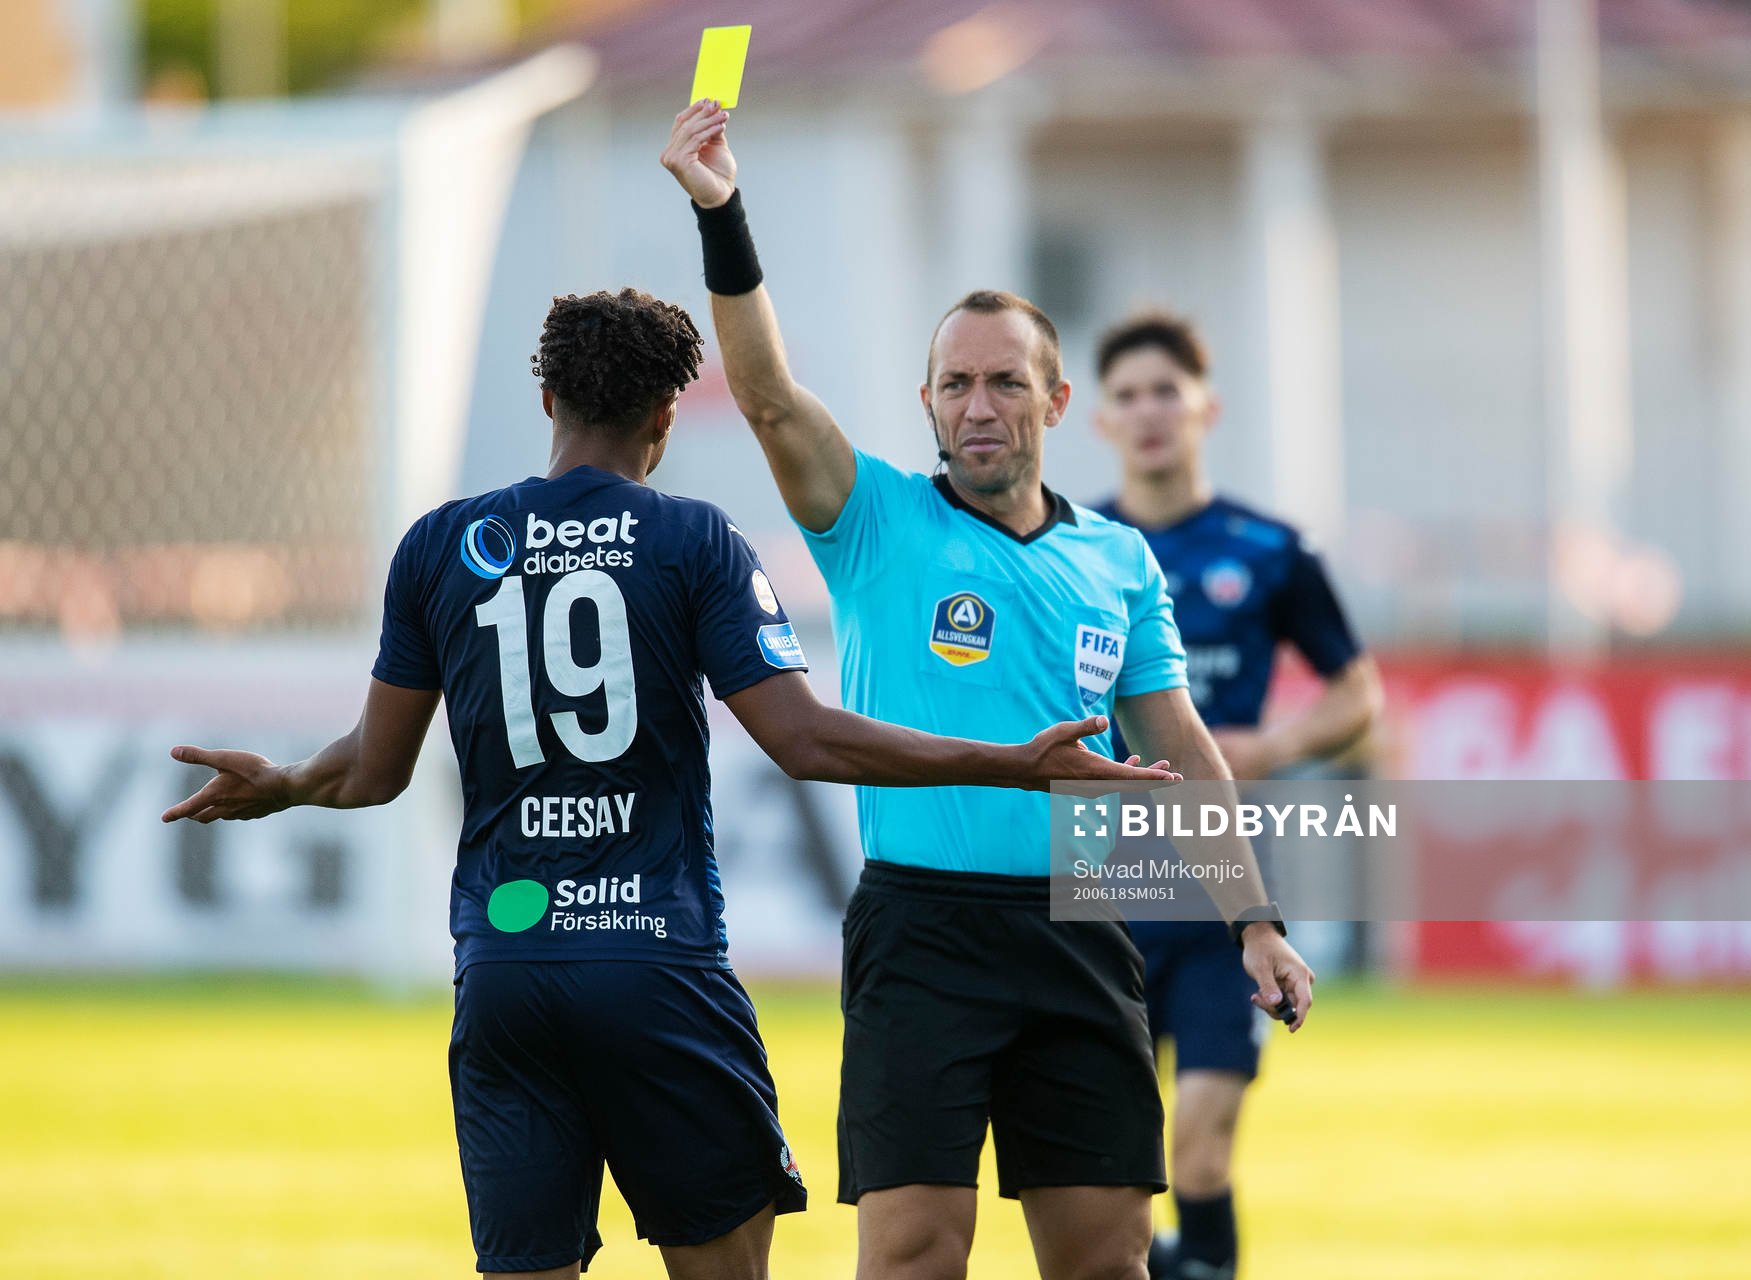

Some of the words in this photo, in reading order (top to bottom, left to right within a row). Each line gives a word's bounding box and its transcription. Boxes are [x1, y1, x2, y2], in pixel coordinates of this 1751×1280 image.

[525, 510, 639, 550] beat
[523, 546, 634, 575] diabetes
[936, 629, 987, 648] ALLSVENSKAN
[1081, 631, 1119, 659] FIFA
[475, 569, 639, 769] 19
[1078, 662, 1114, 681] REFEREE
[520, 792, 636, 838] CEESAY
[554, 873, 641, 907] Solid
[551, 909, 668, 939] Försäkring
